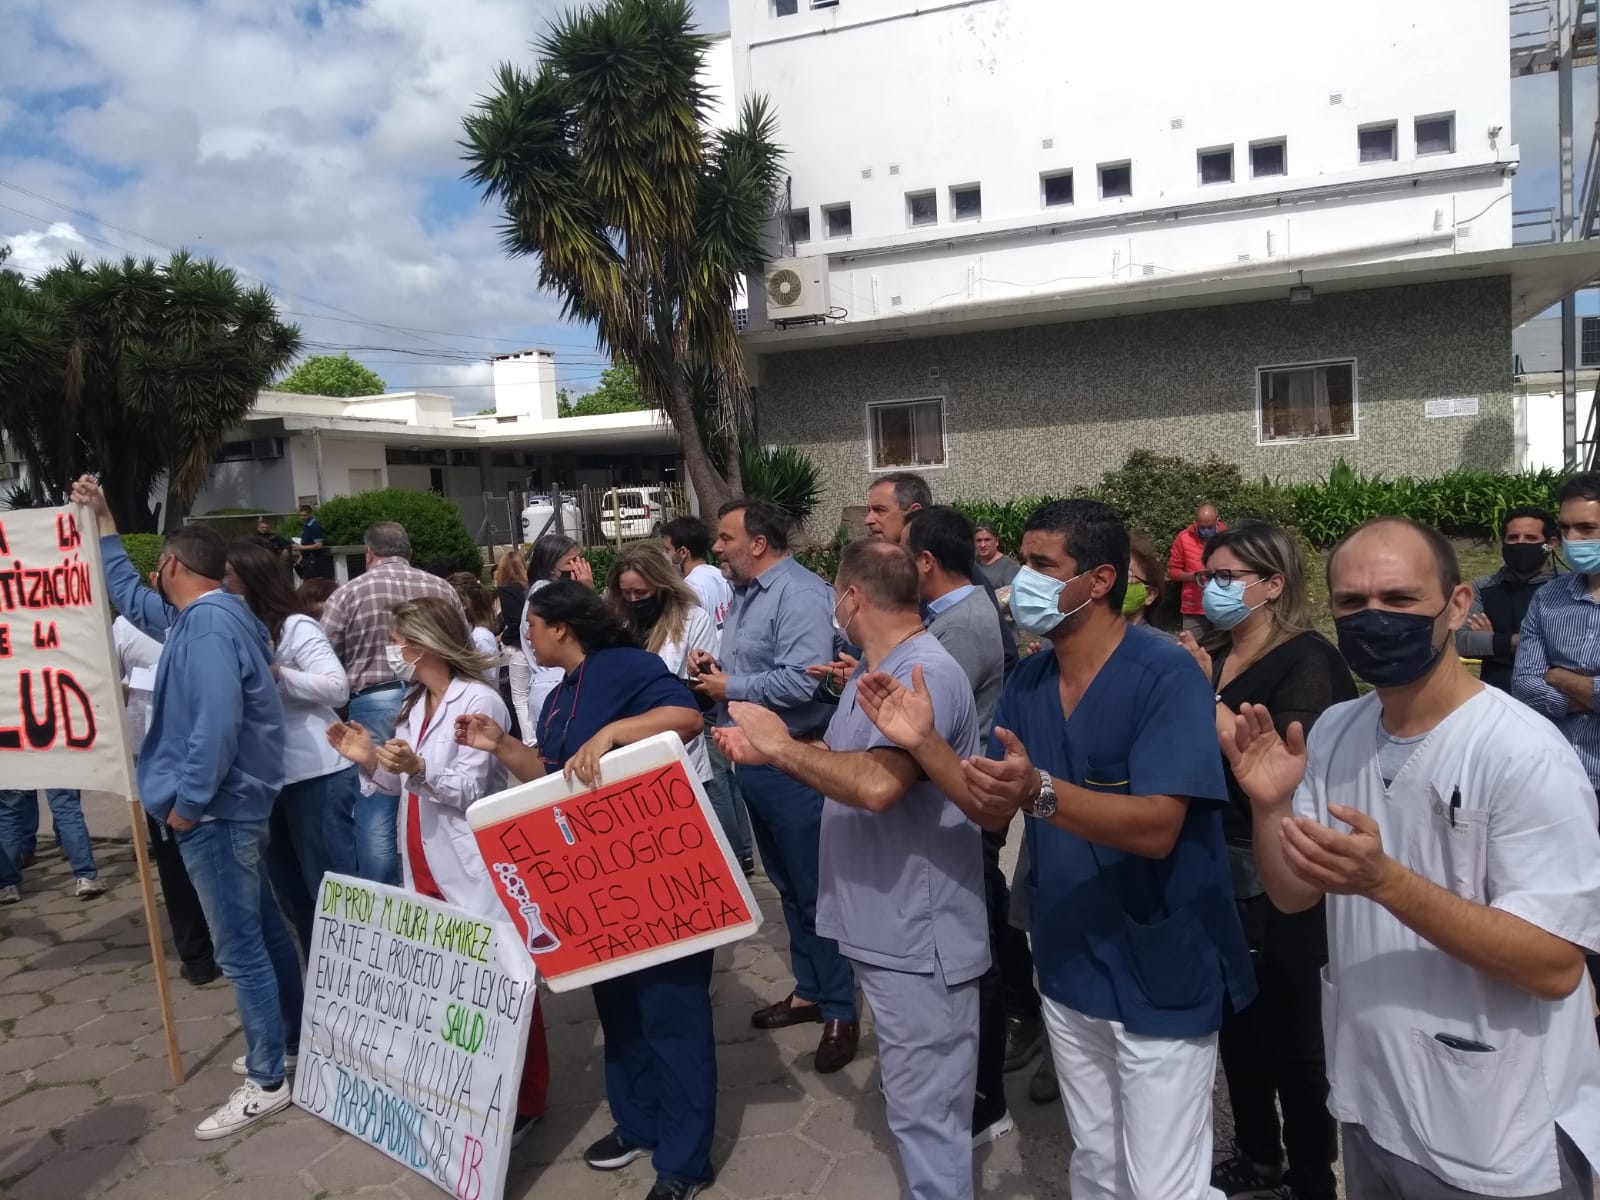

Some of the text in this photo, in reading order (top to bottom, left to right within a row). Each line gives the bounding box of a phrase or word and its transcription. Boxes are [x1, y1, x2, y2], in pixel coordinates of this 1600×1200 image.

[57, 513, 81, 551] LA
[33, 620, 61, 651] LA
[499, 823, 550, 865] EL
[345, 886, 376, 924] PROV
[395, 901, 429, 943] LAURA
[545, 861, 725, 942] NO ES UNA
[319, 916, 366, 962] TRATE
[368, 931, 383, 971] EL
[388, 939, 443, 989] PROYECTO
[449, 959, 469, 1000] DE
[471, 966, 497, 1010] LEY
[315, 955, 336, 992] EN
[337, 963, 352, 1000] LA
[415, 994, 438, 1034] DE
[299, 1053, 331, 1114] LOS
[309, 994, 387, 1083] ESCUCHE
[384, 1026, 403, 1089] E
[481, 1073, 502, 1147] A
